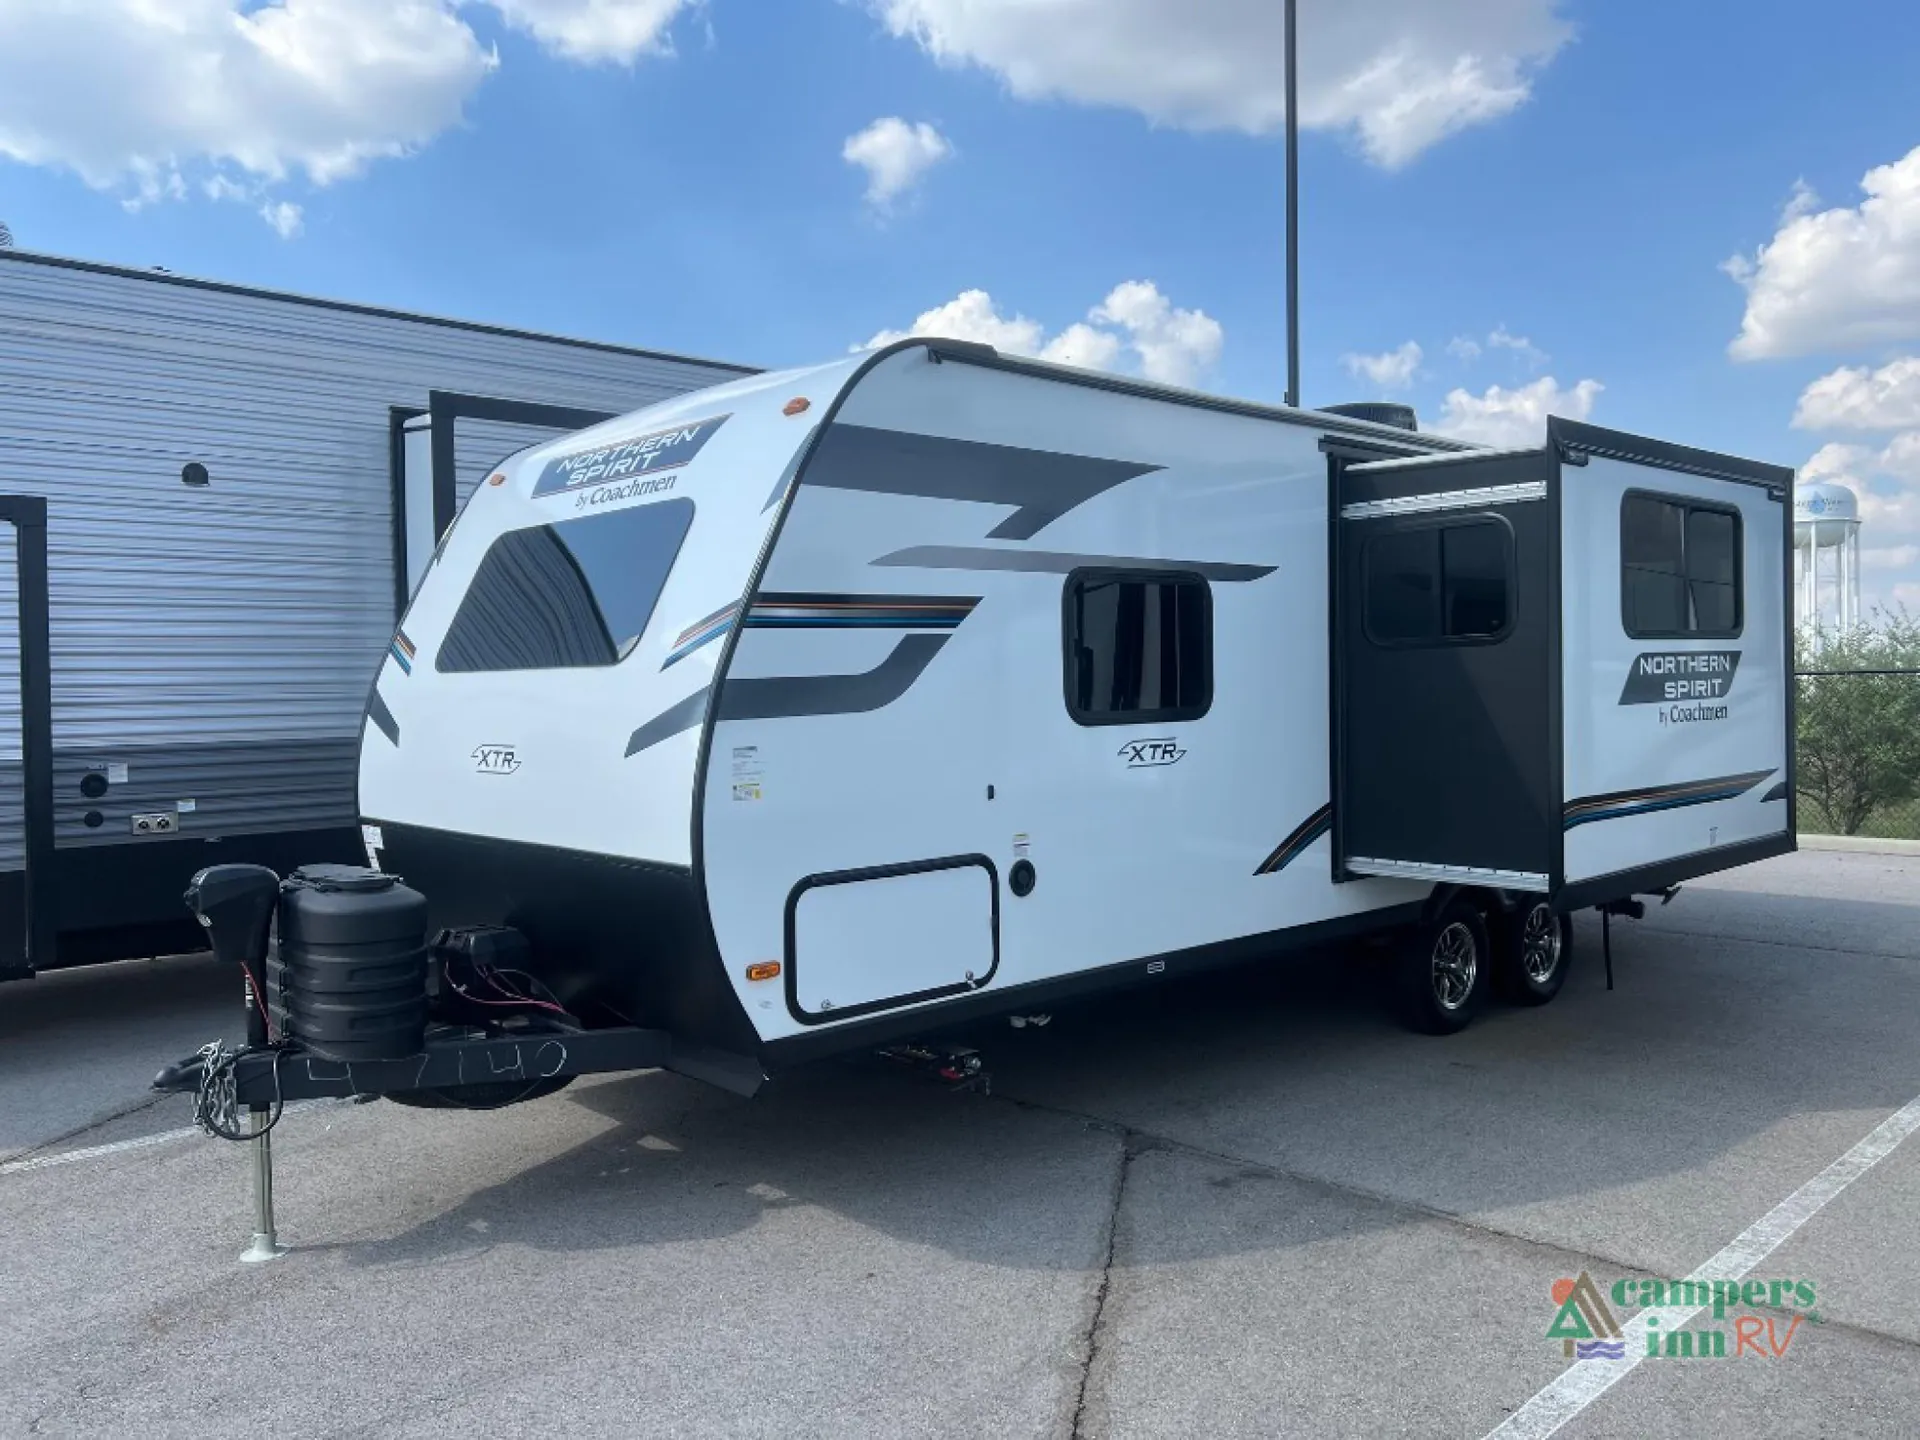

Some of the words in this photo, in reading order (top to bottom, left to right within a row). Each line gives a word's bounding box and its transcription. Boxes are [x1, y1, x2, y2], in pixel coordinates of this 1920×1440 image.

[556, 424, 701, 473] NORTHERN
[566, 451, 661, 486] SPIRIT
[575, 493, 587, 510] by
[590, 475, 678, 506] Coachmen
[1640, 654, 1730, 676] NORTHERN
[1664, 678, 1722, 699] SPIRIT
[1659, 706, 1669, 727] by
[1670, 702, 1728, 723] Coachmen
[477, 749, 515, 769] XTR
[1128, 742, 1177, 762] XTR
